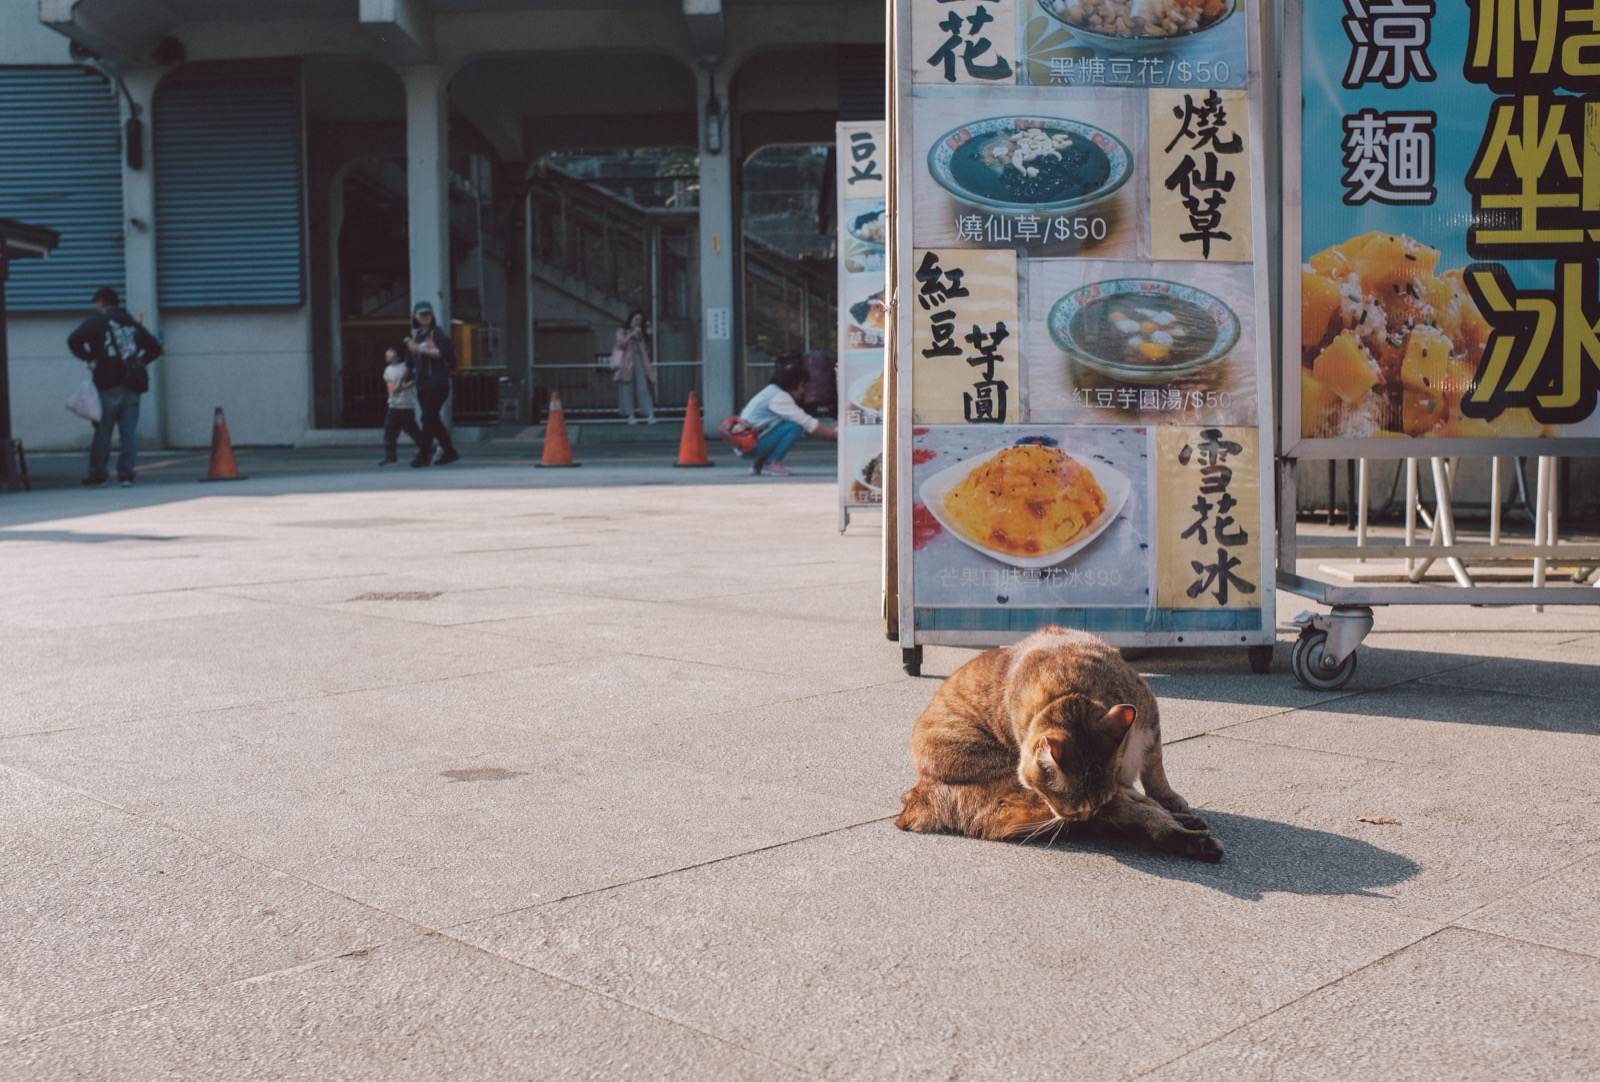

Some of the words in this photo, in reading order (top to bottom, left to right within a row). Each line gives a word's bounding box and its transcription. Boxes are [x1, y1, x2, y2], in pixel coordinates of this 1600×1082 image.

[927, 0, 1013, 82] 花
[1049, 56, 1230, 85] 黑糖豆花/$50
[1164, 89, 1244, 259] 燒仙草
[955, 214, 1108, 243] 燒仙草/$50
[1071, 386, 1232, 411] 紅豆芋圓湯/$50
[1178, 428, 1257, 605] 雪花冰
[940, 566, 1122, 589] 芒果口味雪花冰$90
